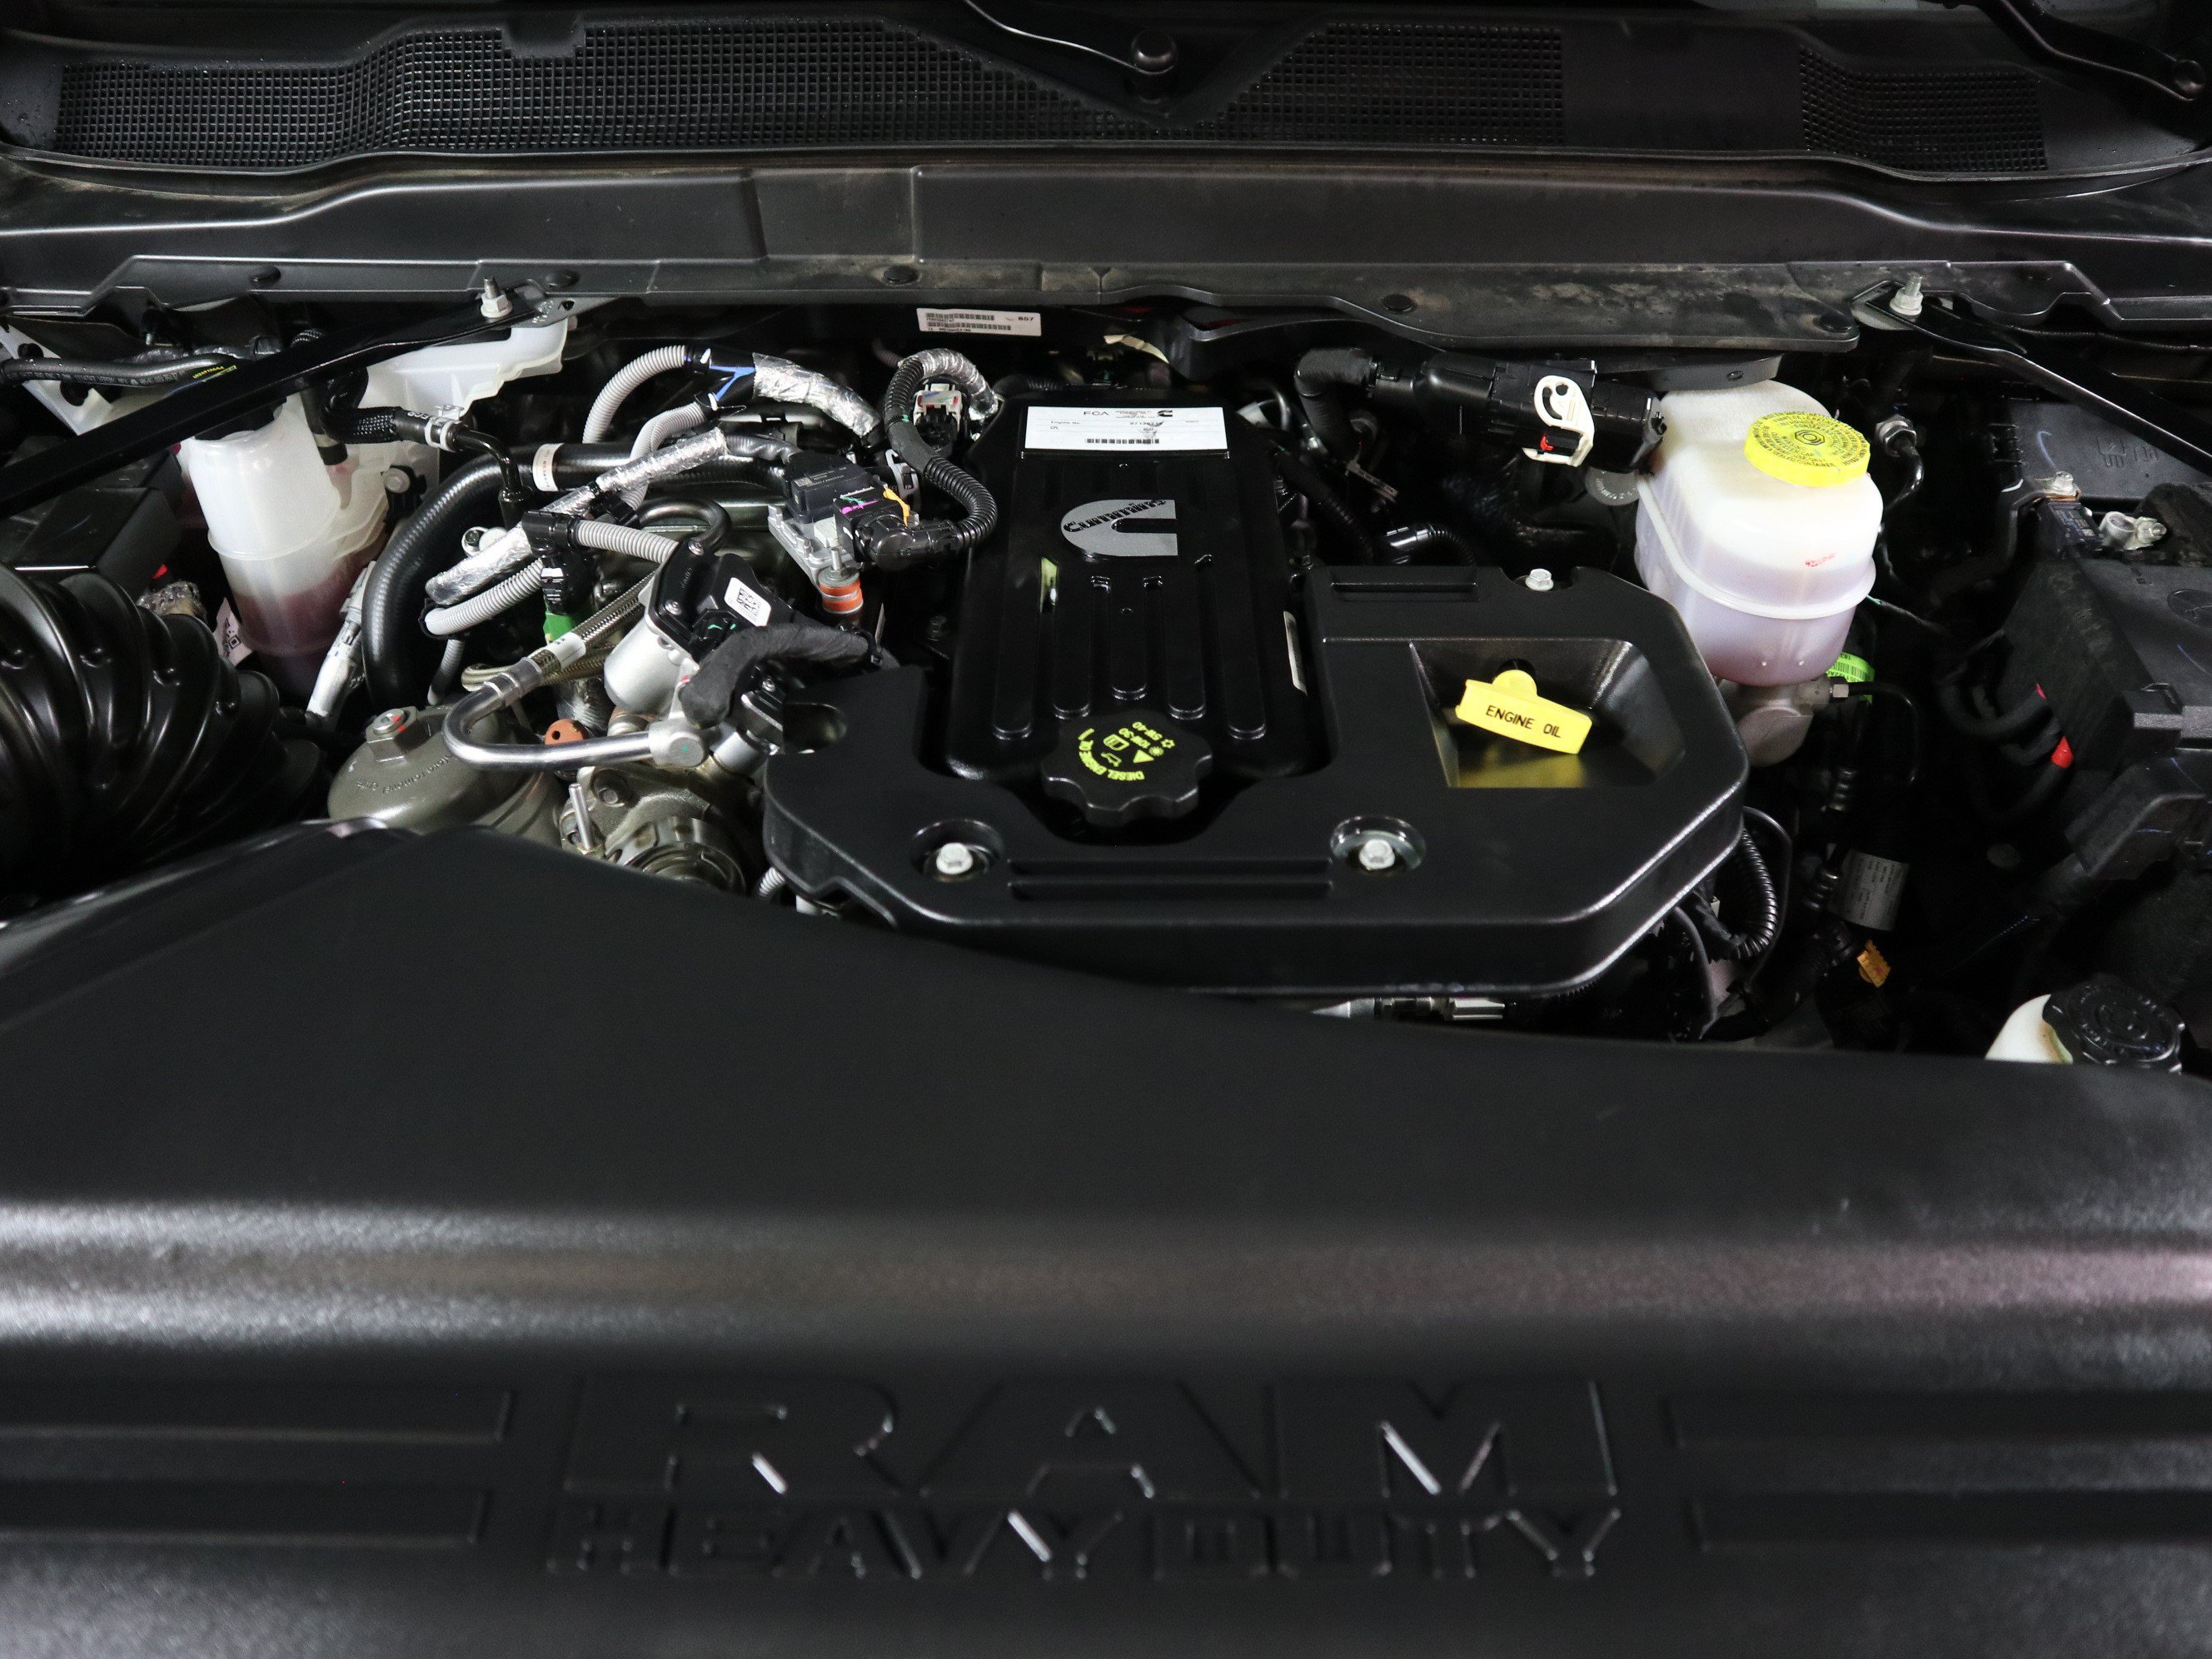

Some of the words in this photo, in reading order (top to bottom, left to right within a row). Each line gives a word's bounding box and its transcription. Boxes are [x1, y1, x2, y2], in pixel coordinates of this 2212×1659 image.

[1064, 500, 1166, 532] Cummins
[1486, 705, 1535, 730] ENGINE
[1543, 723, 1561, 738] OIL
[1108, 769, 1145, 781] DIESEL
[560, 1376, 1620, 1498] RAM
[548, 1506, 1128, 1579] HEAVY
[1153, 1504, 1627, 1579] DUTY
